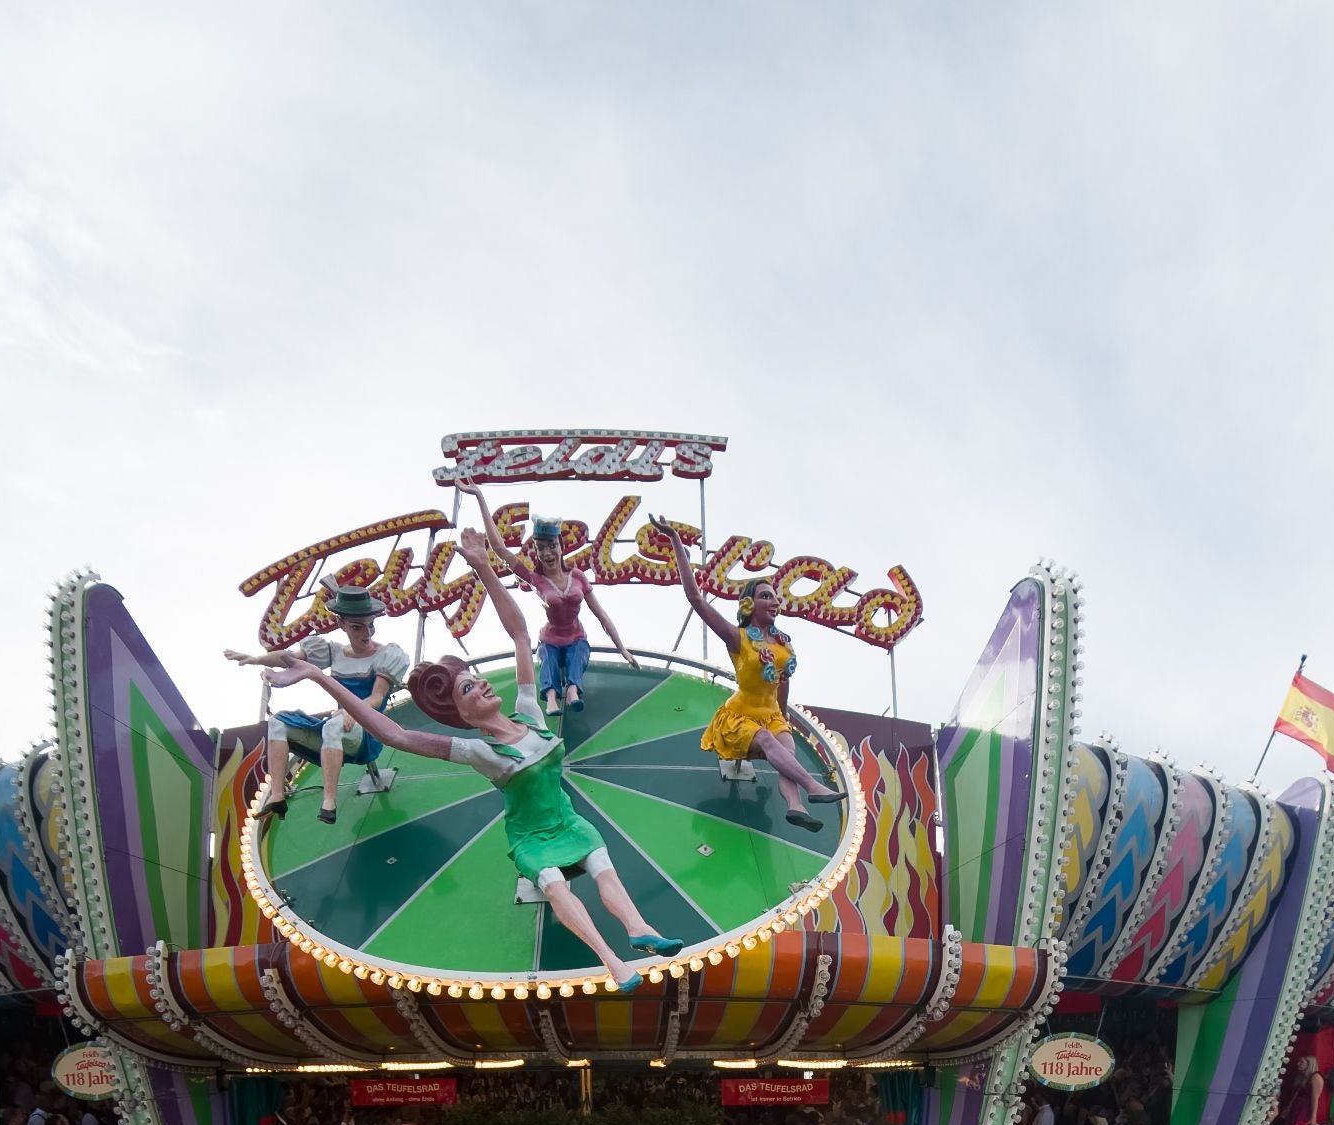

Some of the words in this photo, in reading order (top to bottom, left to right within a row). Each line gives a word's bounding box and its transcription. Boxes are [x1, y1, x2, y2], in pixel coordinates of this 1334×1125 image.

[74, 1060, 108, 1071] Teufelsra
[1041, 1062, 1063, 1076] 118
[1067, 1062, 1103, 1078] Jahre
[63, 1072, 85, 1086] 118
[88, 1069, 116, 1087] Jahr
[367, 1083, 384, 1093] DAS
[386, 1083, 439, 1093] TEUFELSRAD
[739, 1083, 757, 1093] DAS
[760, 1083, 813, 1093] TEUFELSRAD
